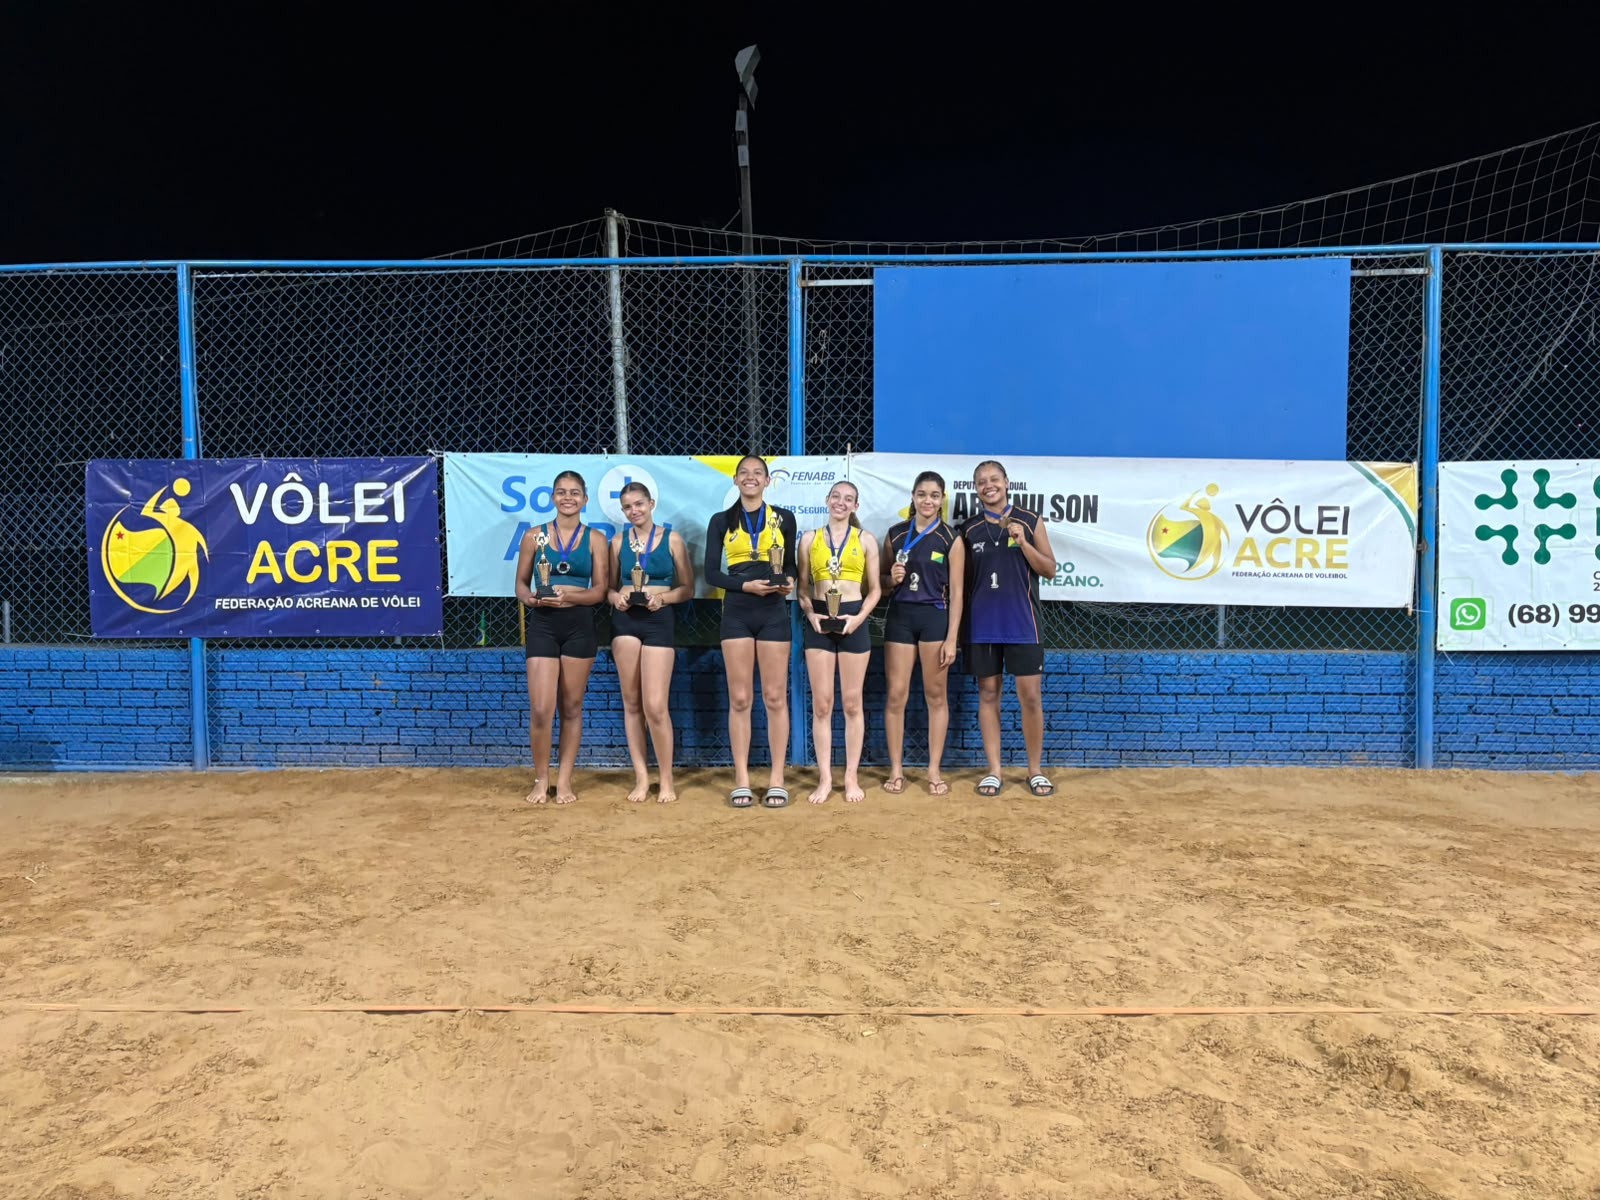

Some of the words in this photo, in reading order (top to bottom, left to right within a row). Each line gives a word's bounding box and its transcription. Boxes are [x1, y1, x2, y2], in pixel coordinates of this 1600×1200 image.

[791, 471, 836, 481] FENABB
[229, 472, 405, 525] VÔLEI
[500, 475, 587, 514] So
[1235, 497, 1350, 536] VÔLEI
[246, 540, 401, 584] ACRE
[1232, 537, 1349, 569] ACRE
[909, 572, 919, 591] 2
[990, 572, 999, 588] 1
[1039, 575, 1104, 587] REANO.
[1231, 571, 1272, 579] FEDERAÇÃO
[215, 596, 294, 611] FEDERAÇÃO
[296, 597, 358, 608] ACREANA
[361, 597, 379, 608] DE
[381, 595, 421, 608] VÔLEI
[1508, 603, 1560, 628] (68)
